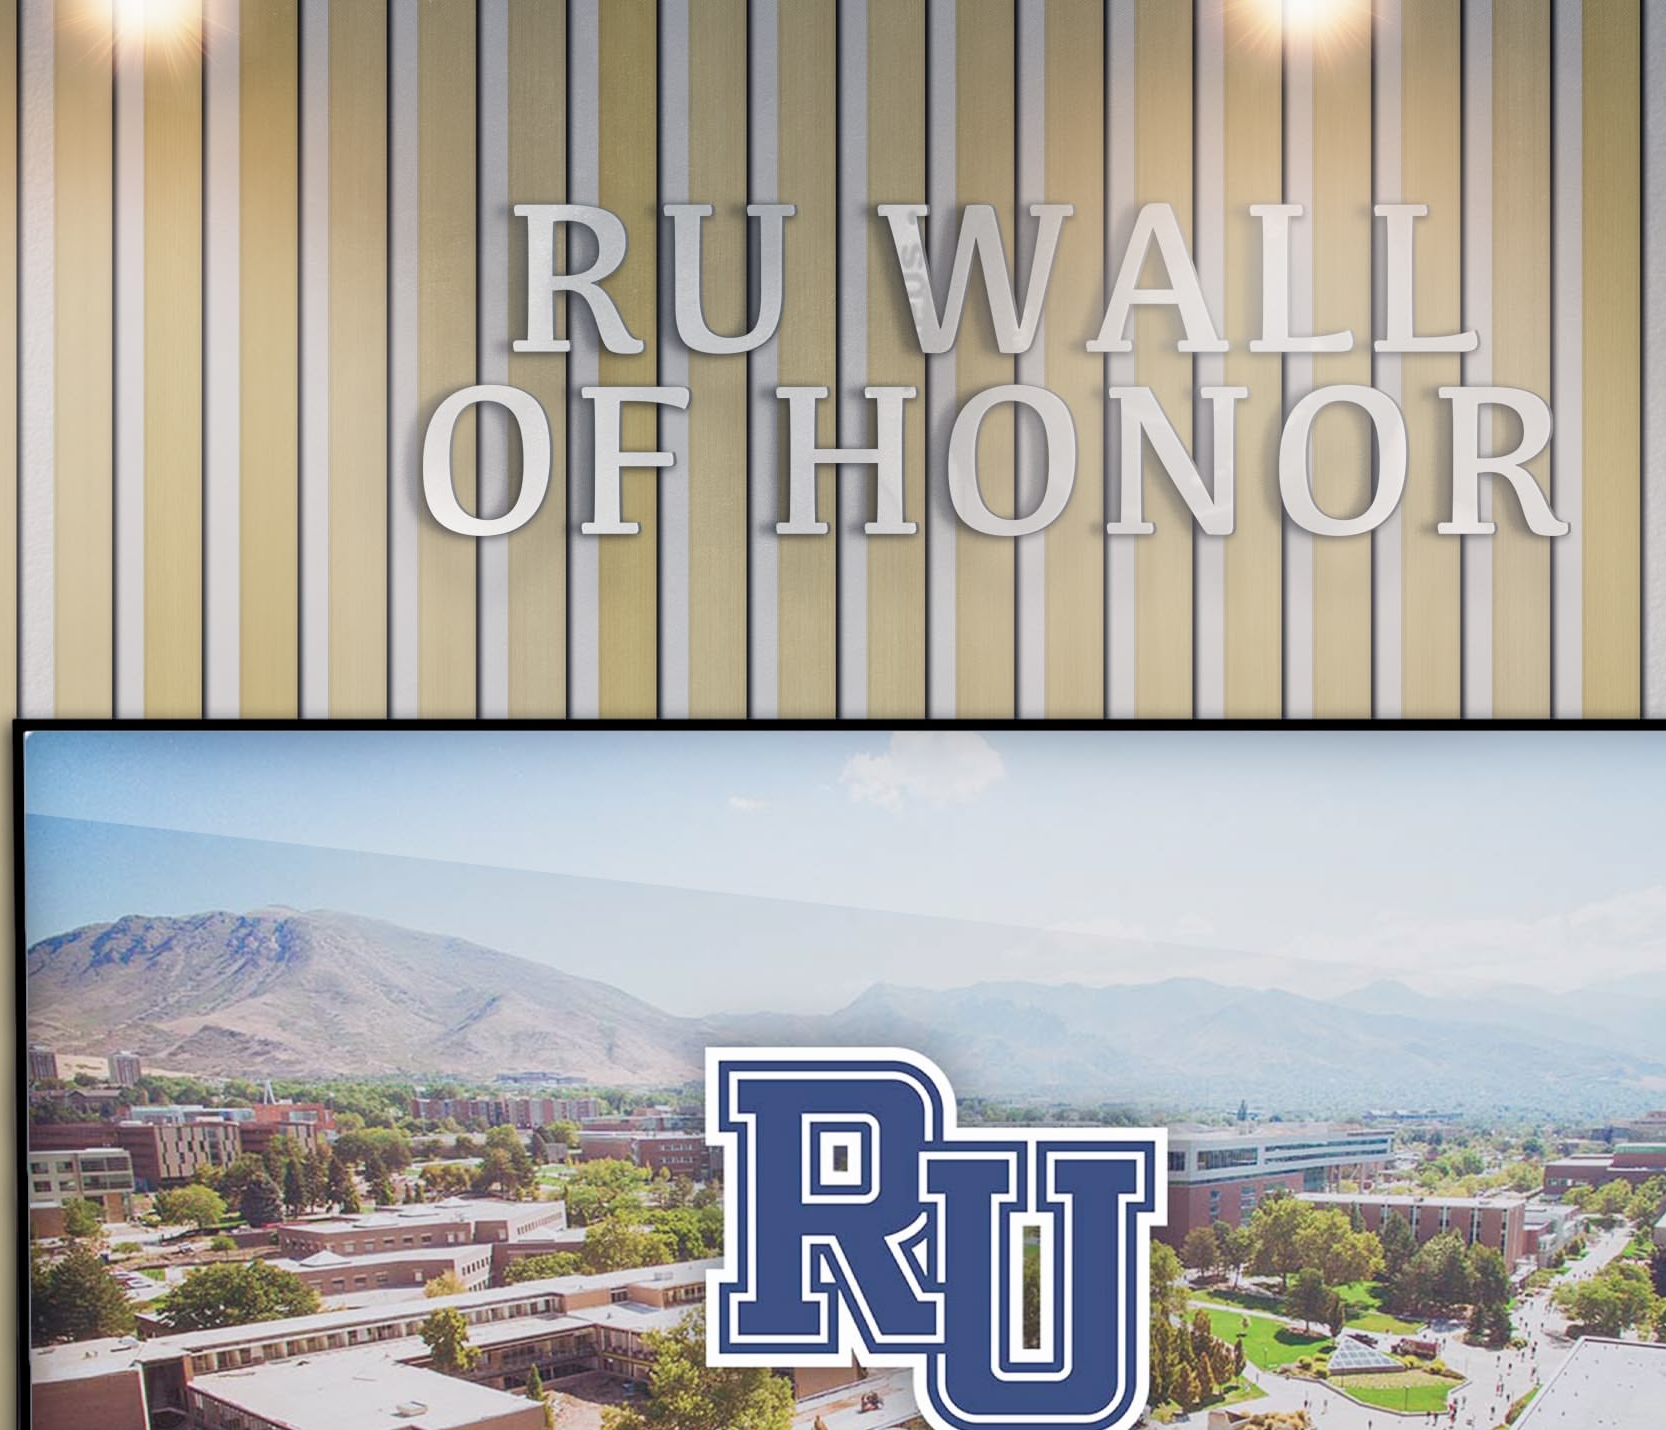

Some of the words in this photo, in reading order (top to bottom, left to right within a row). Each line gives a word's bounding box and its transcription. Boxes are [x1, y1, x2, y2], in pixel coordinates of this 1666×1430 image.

[512, 202, 798, 354] RU
[877, 202, 1479, 354] WALL
[421, 384, 691, 537] OF
[776, 384, 1571, 537] HONOR
